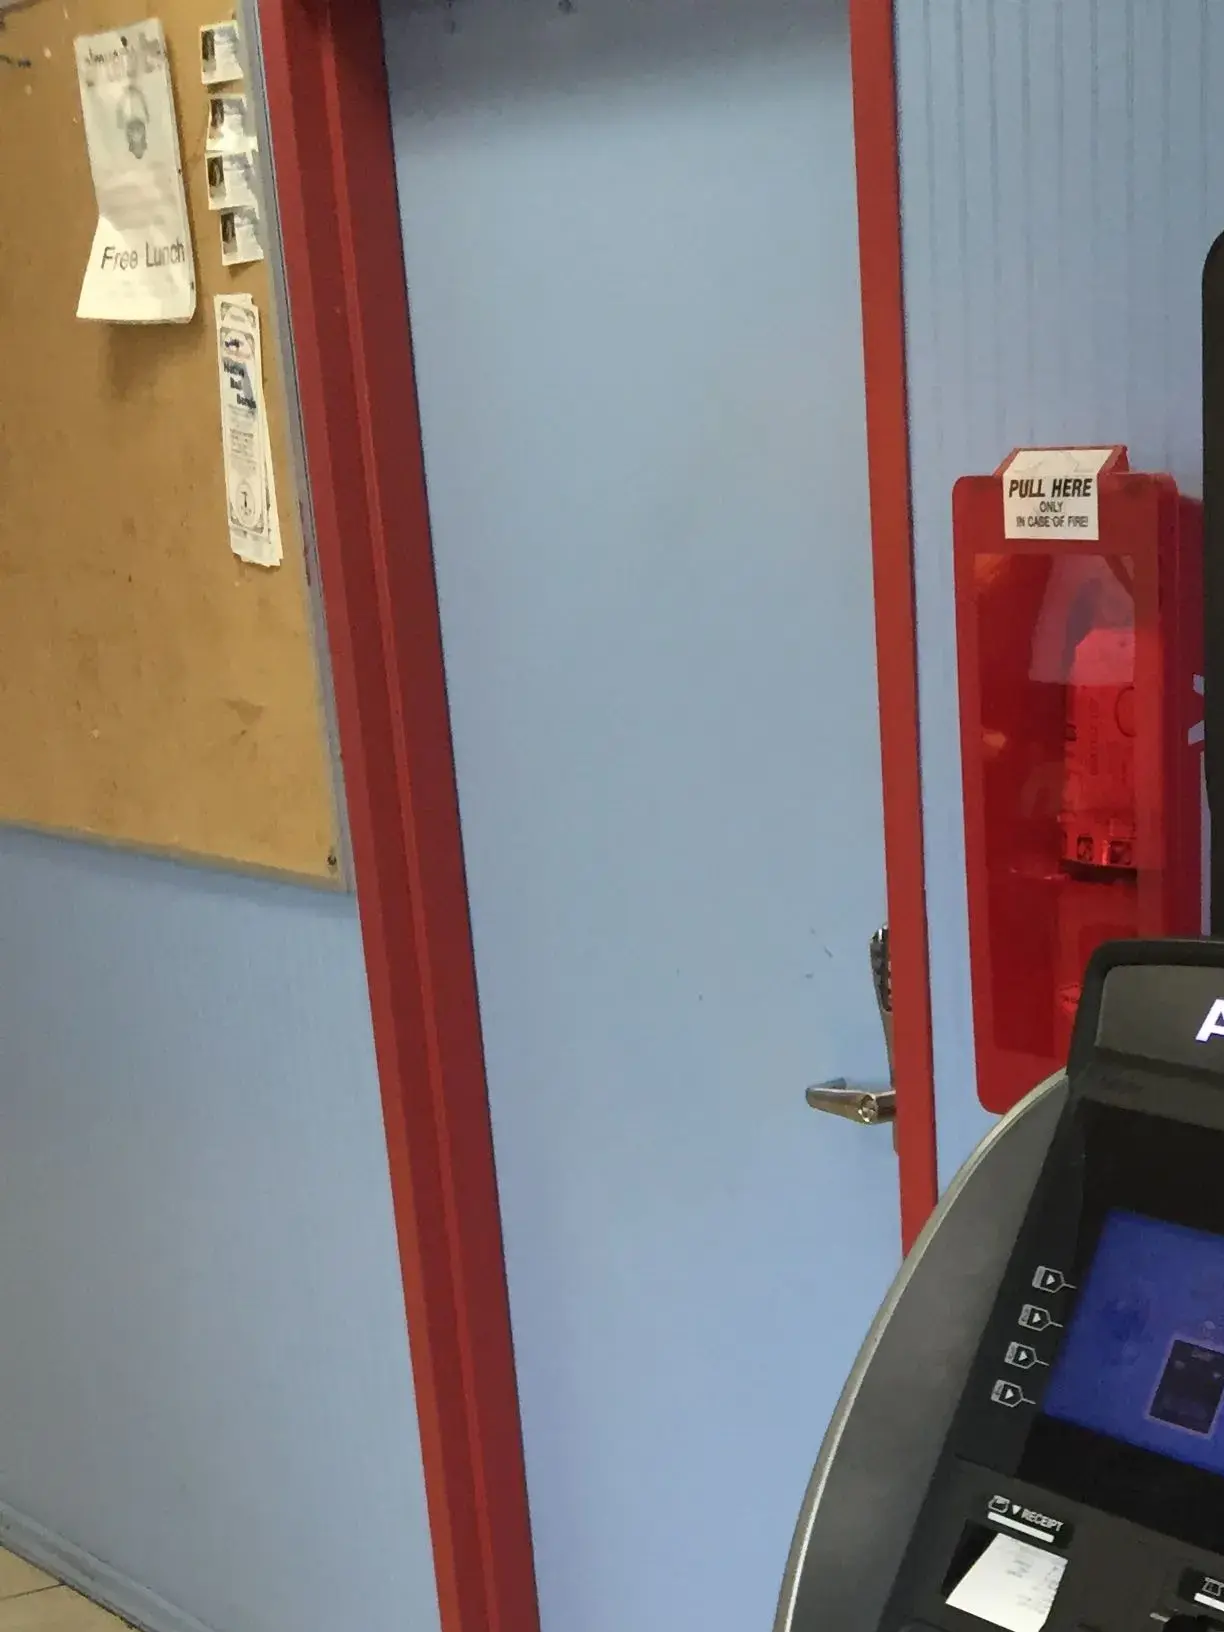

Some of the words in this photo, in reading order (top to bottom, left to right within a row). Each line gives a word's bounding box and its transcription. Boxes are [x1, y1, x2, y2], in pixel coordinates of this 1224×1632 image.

[100, 246, 139, 270] Free
[145, 237, 186, 268] Lunch
[1008, 479, 1046, 498] PULL
[1051, 477, 1093, 498] HERE
[1039, 501, 1064, 513] ONLY
[1016, 516, 1025, 527] IN
[1028, 516, 1051, 528] CASE
[1052, 516, 1065, 528] OF
[1021, 1508, 1065, 1532] RECEIPT
